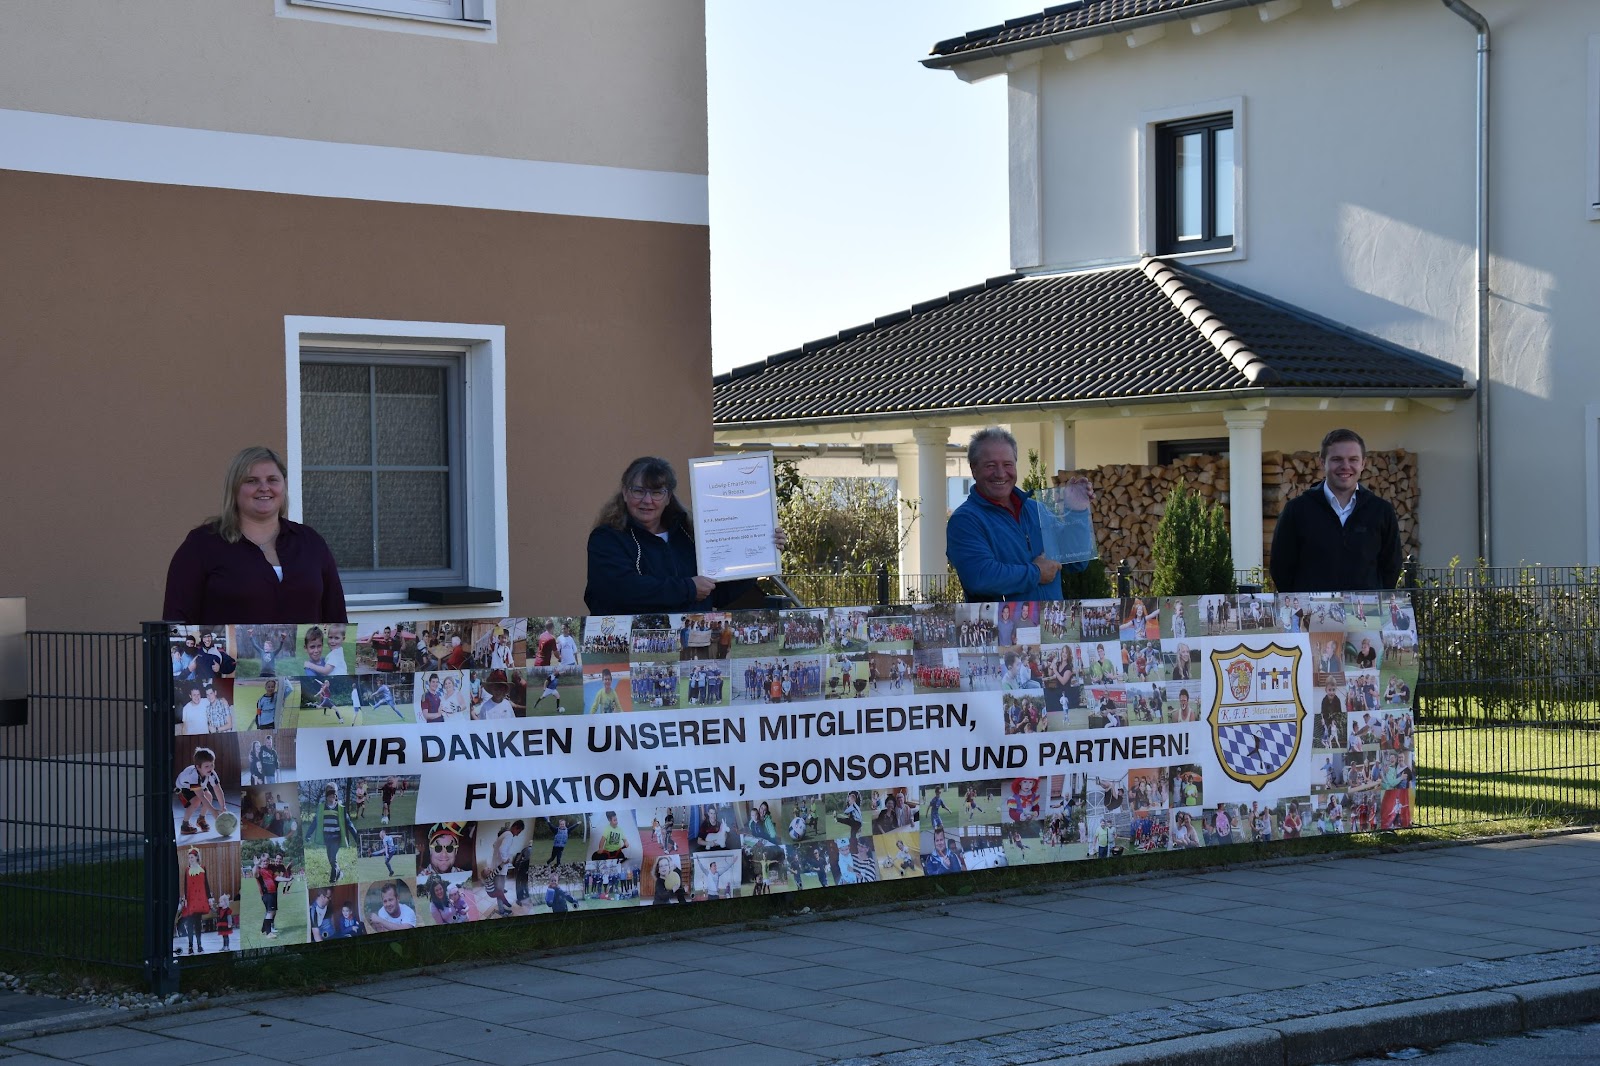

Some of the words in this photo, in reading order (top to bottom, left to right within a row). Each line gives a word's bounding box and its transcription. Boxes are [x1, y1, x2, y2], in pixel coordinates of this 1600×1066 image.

[326, 737, 406, 767] WIR
[421, 727, 573, 763] DANKEN
[588, 717, 746, 752] UNSEREN
[759, 703, 977, 742] MITGLIEDERN,
[464, 765, 746, 810] FUNKTIONÄREN,
[758, 748, 950, 789] SPONSOREN
[961, 745, 1028, 772] UND
[1038, 733, 1190, 767] PARTNERN!
